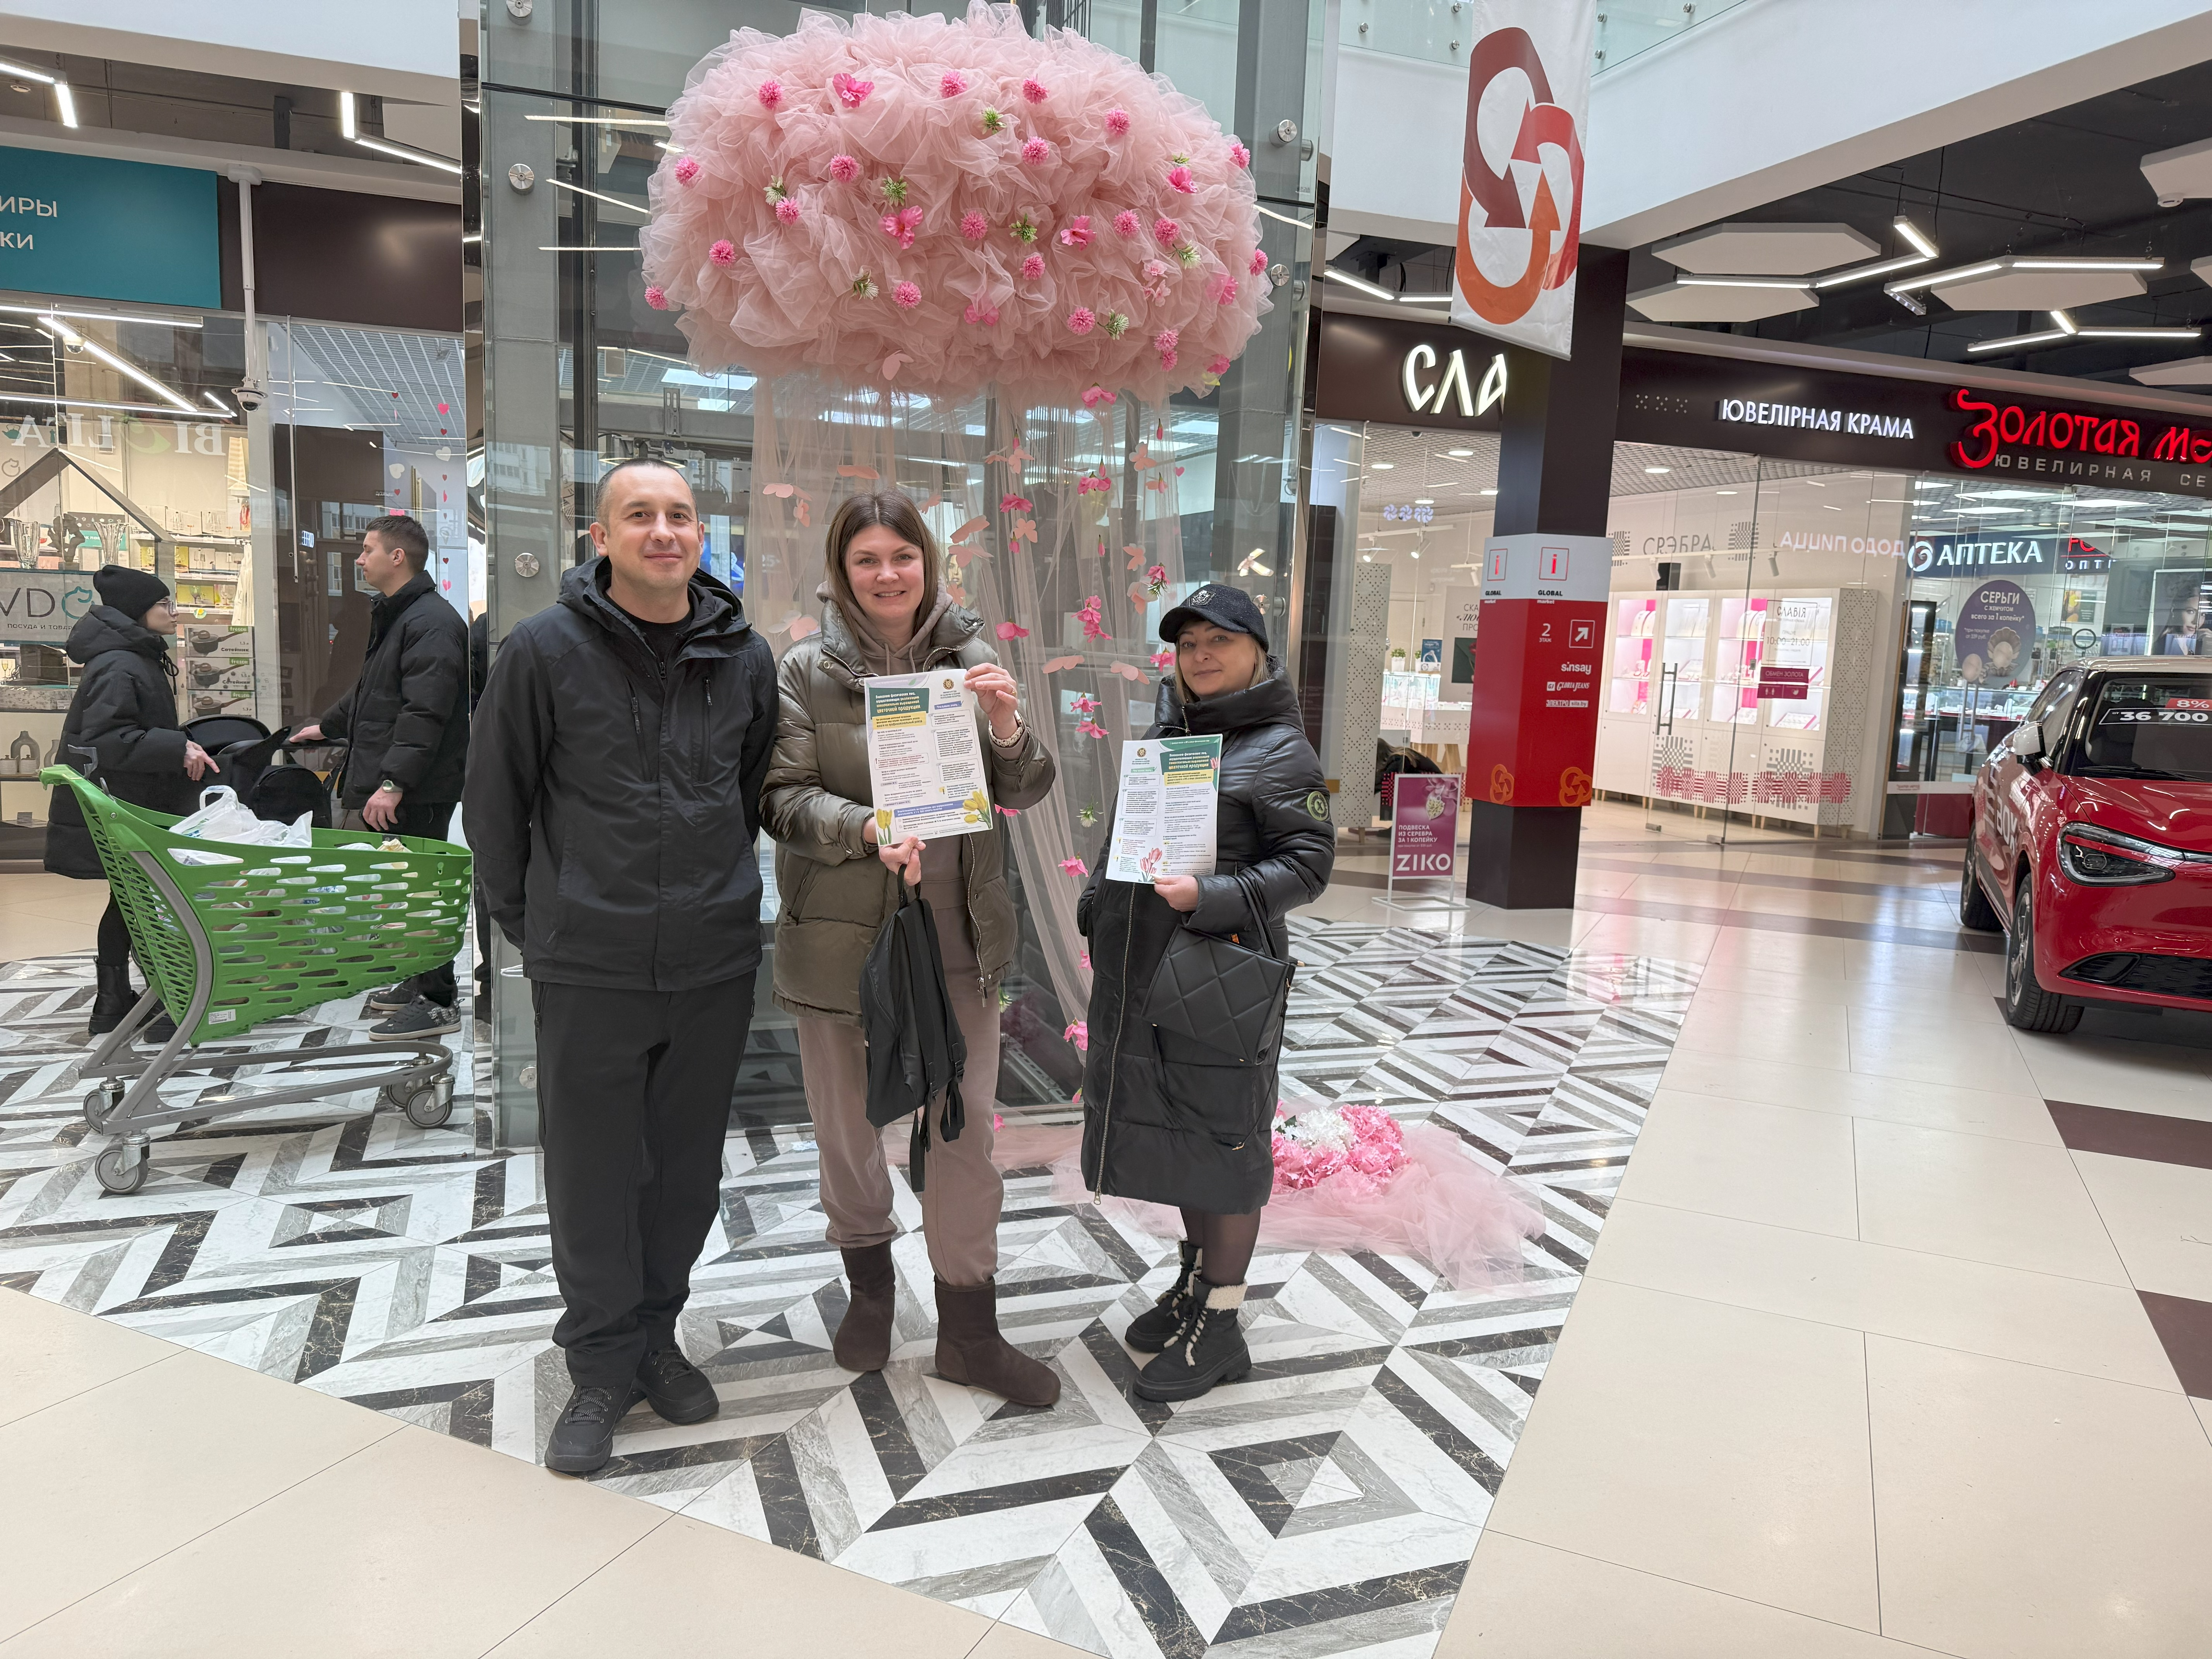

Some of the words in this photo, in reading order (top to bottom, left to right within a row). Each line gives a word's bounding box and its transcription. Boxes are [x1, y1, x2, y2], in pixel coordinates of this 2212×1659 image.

[1720, 399, 1841, 432] ЮВЕЛІРНАЯ
[1846, 412, 1915, 439] КРАМА
[1995, 454, 2150, 482] ЮВЕЛИРНАЯ
[1643, 534, 1712, 556] СРЭБРА
[1936, 541, 2043, 566] АПТЕКА
[1980, 591, 2020, 604] СЕРЬГИ
[1777, 606, 1806, 618] СЛАВІЯ
[1542, 623, 1551, 636] 2
[1561, 661, 1592, 675] sinsay
[2120, 712, 2151, 721] 36
[2159, 712, 2209, 722] 700
[1396, 854, 1451, 871] ZIKO
